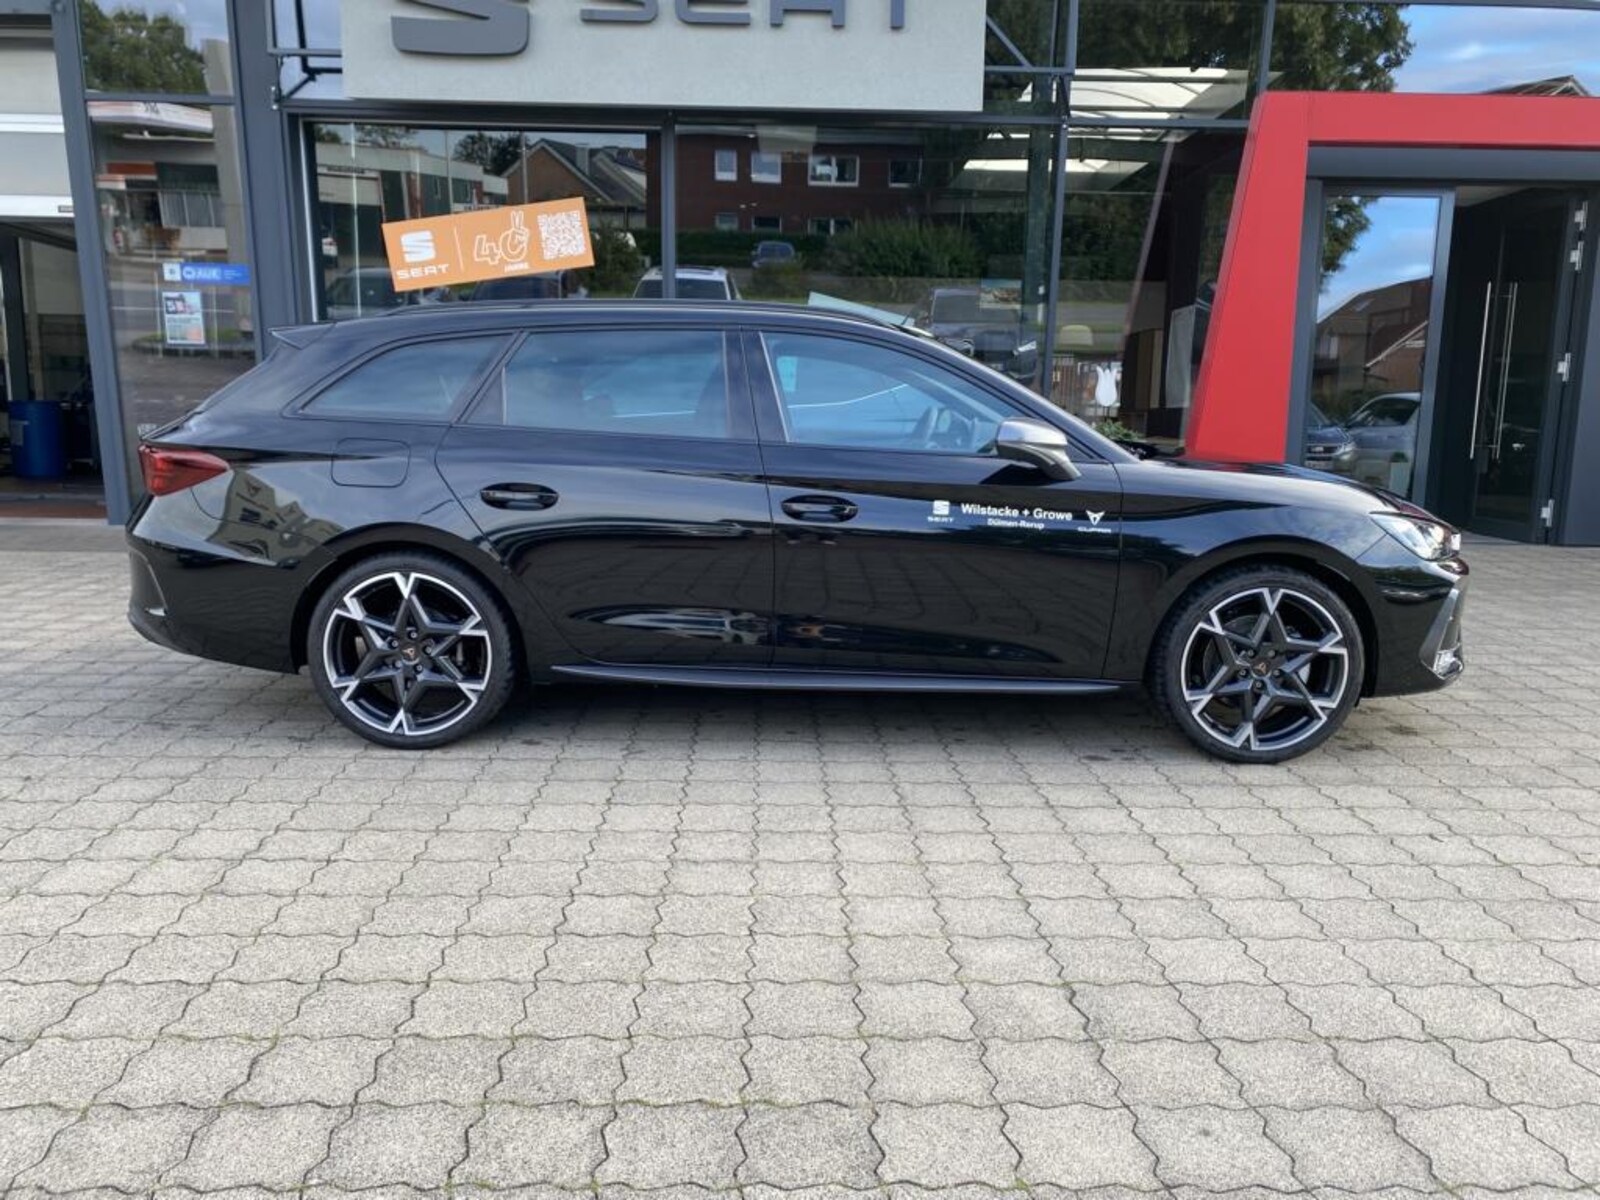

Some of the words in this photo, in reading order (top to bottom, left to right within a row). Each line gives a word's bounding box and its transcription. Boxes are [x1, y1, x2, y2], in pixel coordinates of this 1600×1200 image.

[396, 263, 449, 279] SEAT
[961, 503, 1019, 518] Wilstacke
[1033, 508, 1073, 521] Growe
